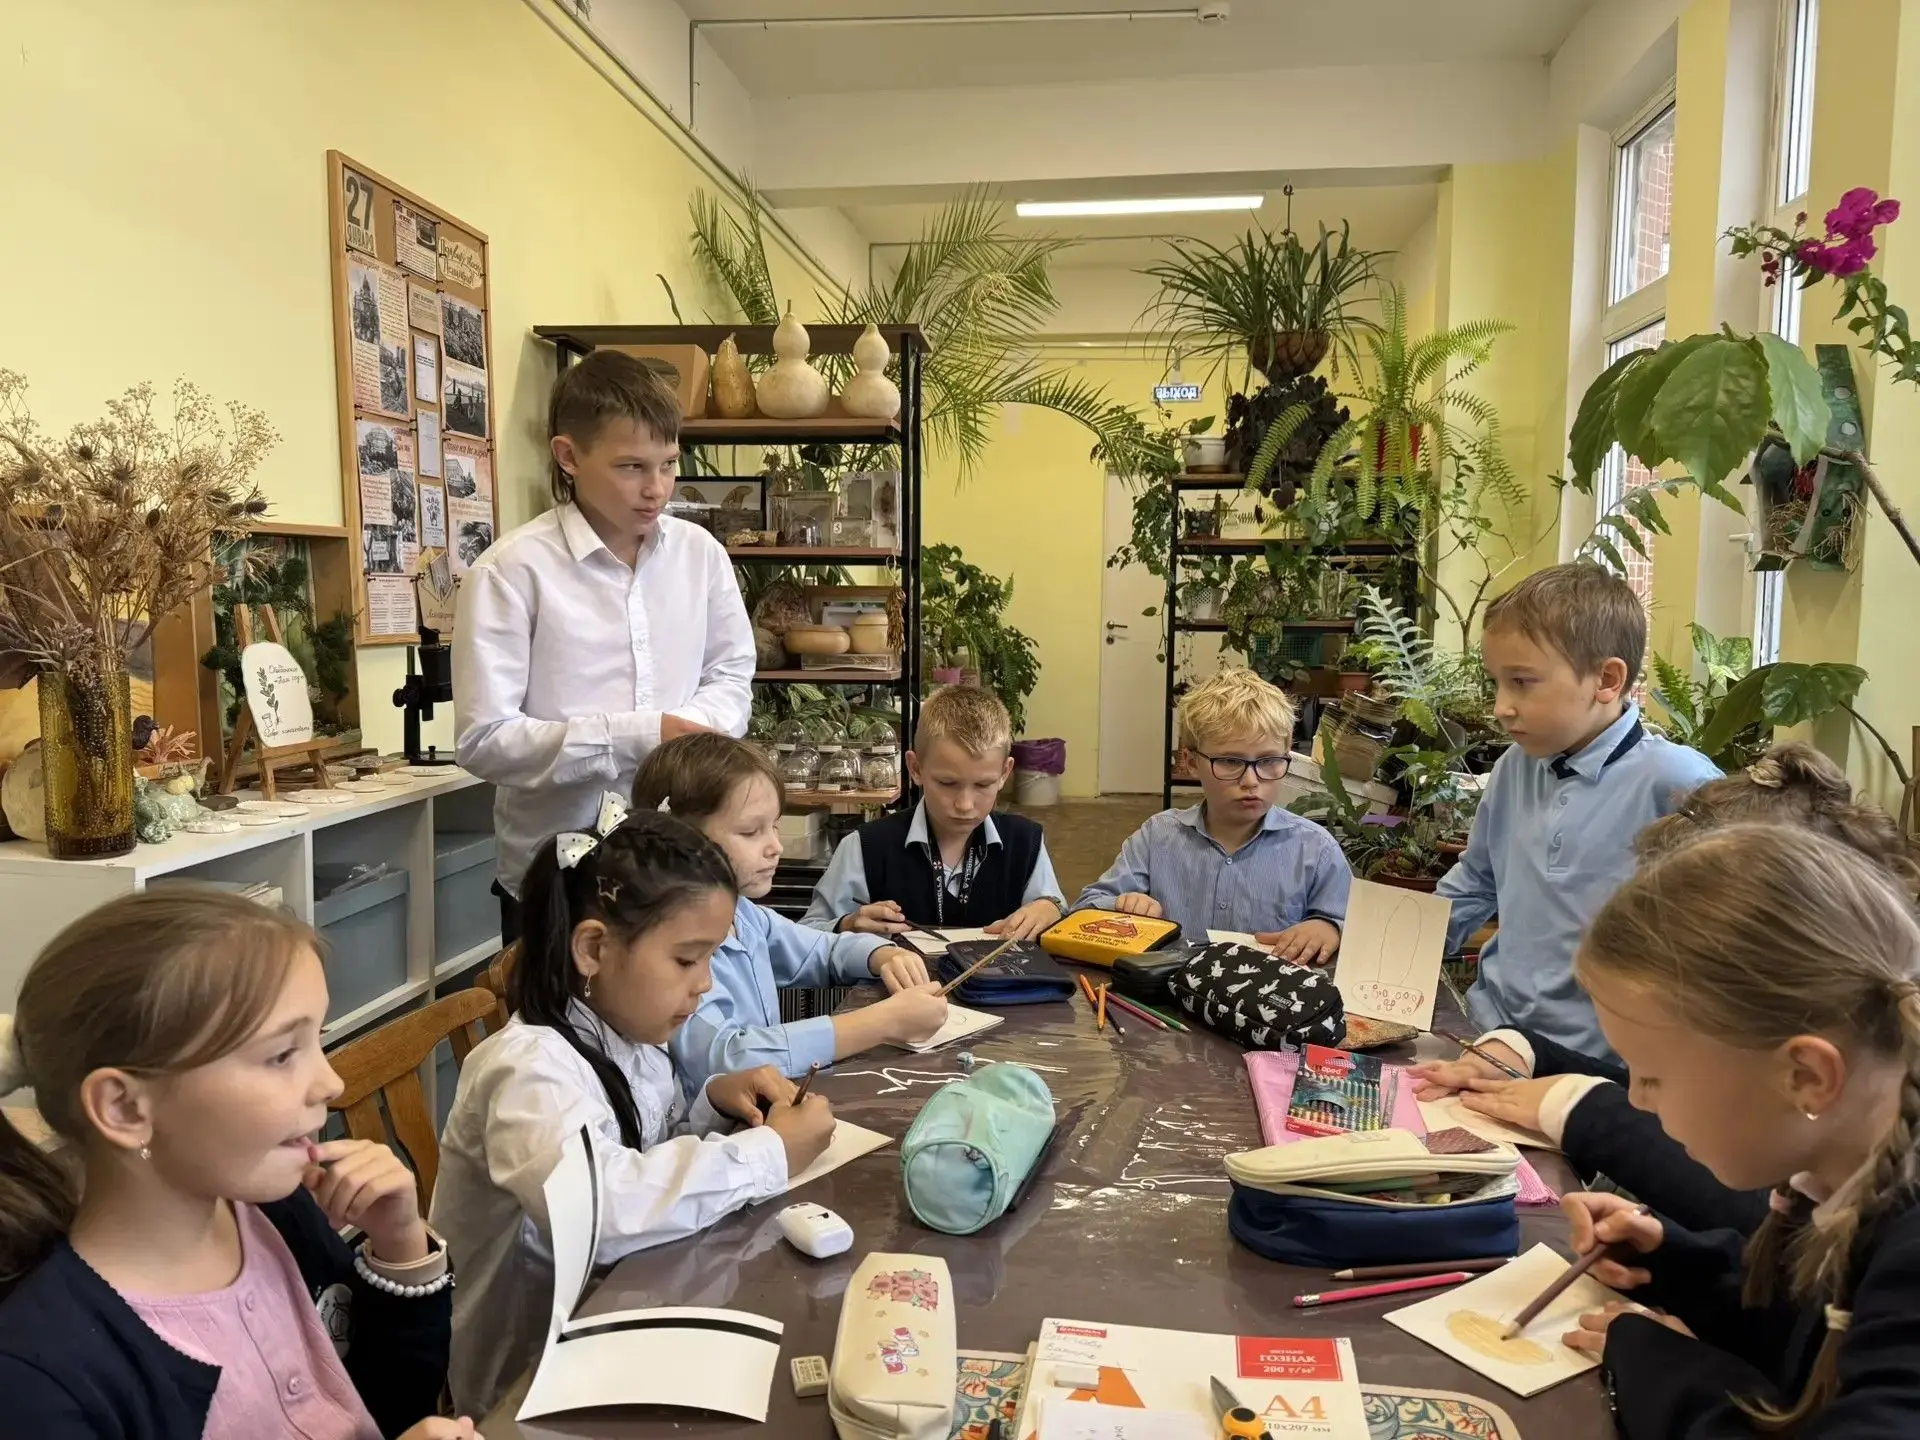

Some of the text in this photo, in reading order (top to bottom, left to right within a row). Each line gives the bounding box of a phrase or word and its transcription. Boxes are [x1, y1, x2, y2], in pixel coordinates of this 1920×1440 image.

[346, 176, 374, 231] 27
[1155, 387, 1197, 400] ВЫХОД
[1259, 1353, 1317, 1364] ГОЗНАК
[1263, 1365, 1285, 1374] 200
[1259, 1394, 1329, 1421] A4
